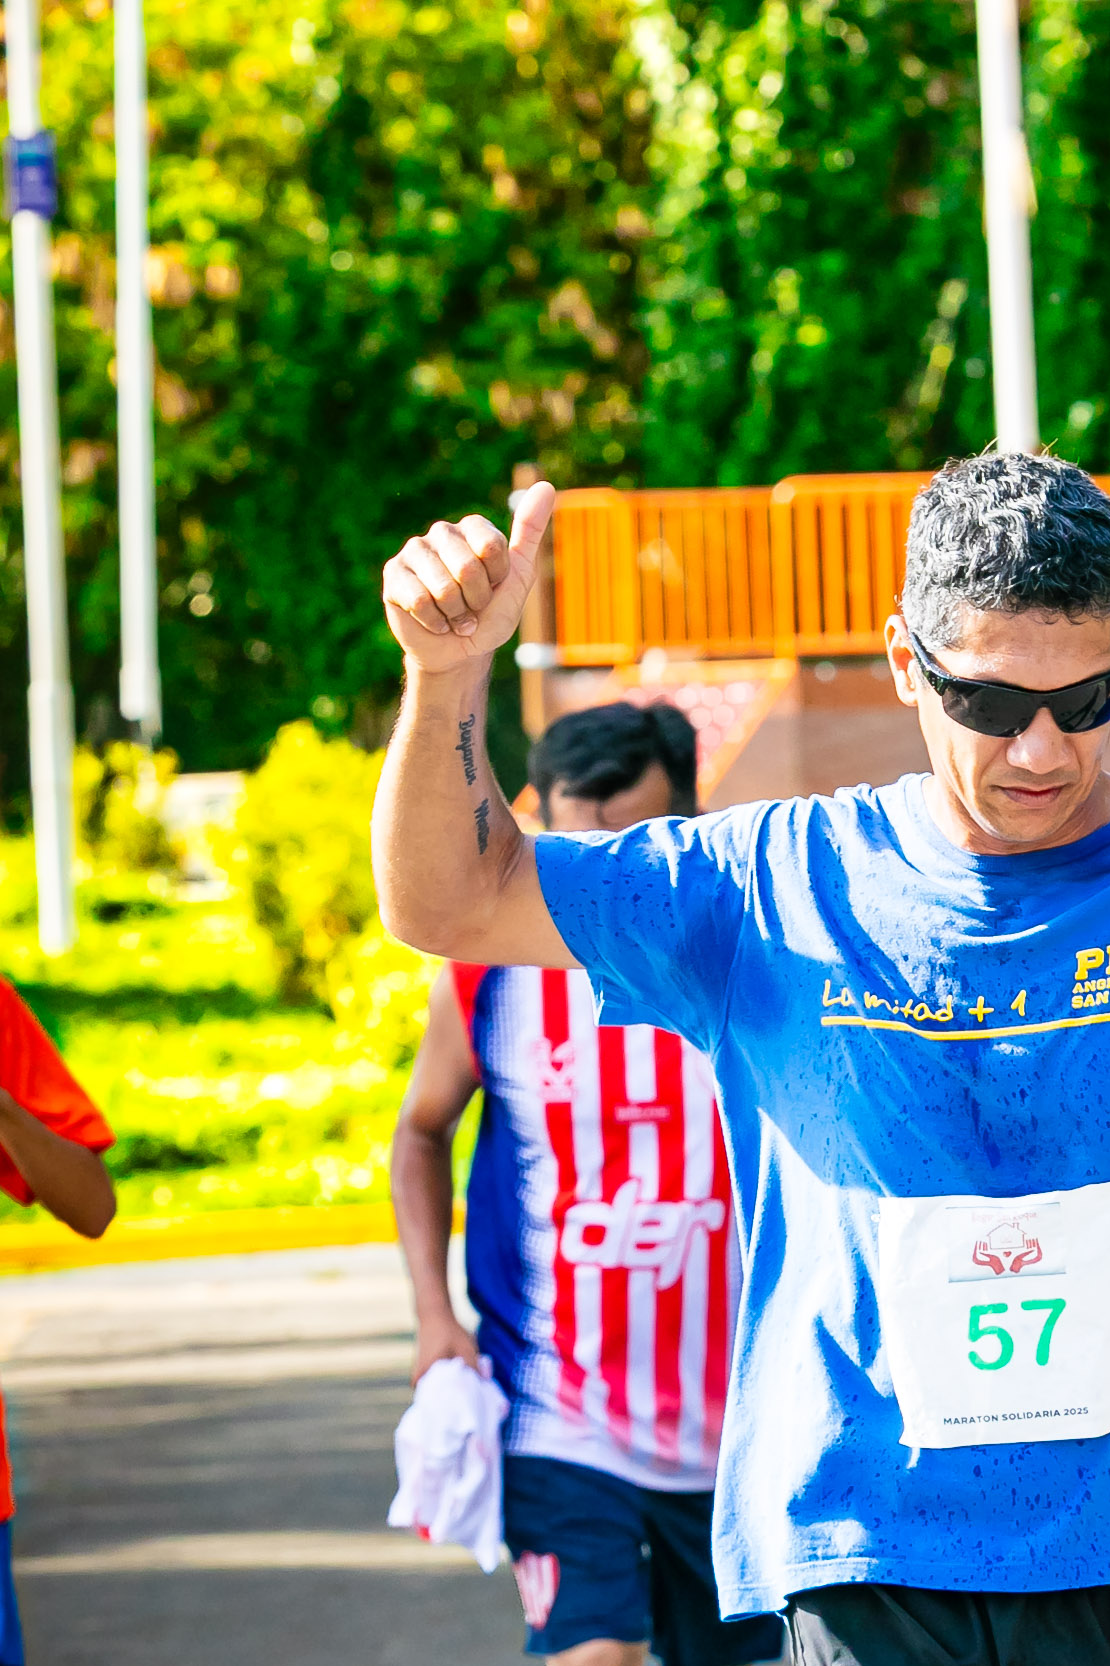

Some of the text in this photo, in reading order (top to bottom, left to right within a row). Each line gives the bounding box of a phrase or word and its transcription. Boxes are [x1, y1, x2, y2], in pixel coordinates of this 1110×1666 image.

[822, 979, 855, 1007] La
[863, 991, 954, 1022] mitad
[1010, 989, 1027, 1016] 1
[1071, 990, 1110, 1009] SAN
[968, 1298, 1067, 1371] 57
[943, 1406, 1090, 1426] MARATON SOLIDARIA 2025
